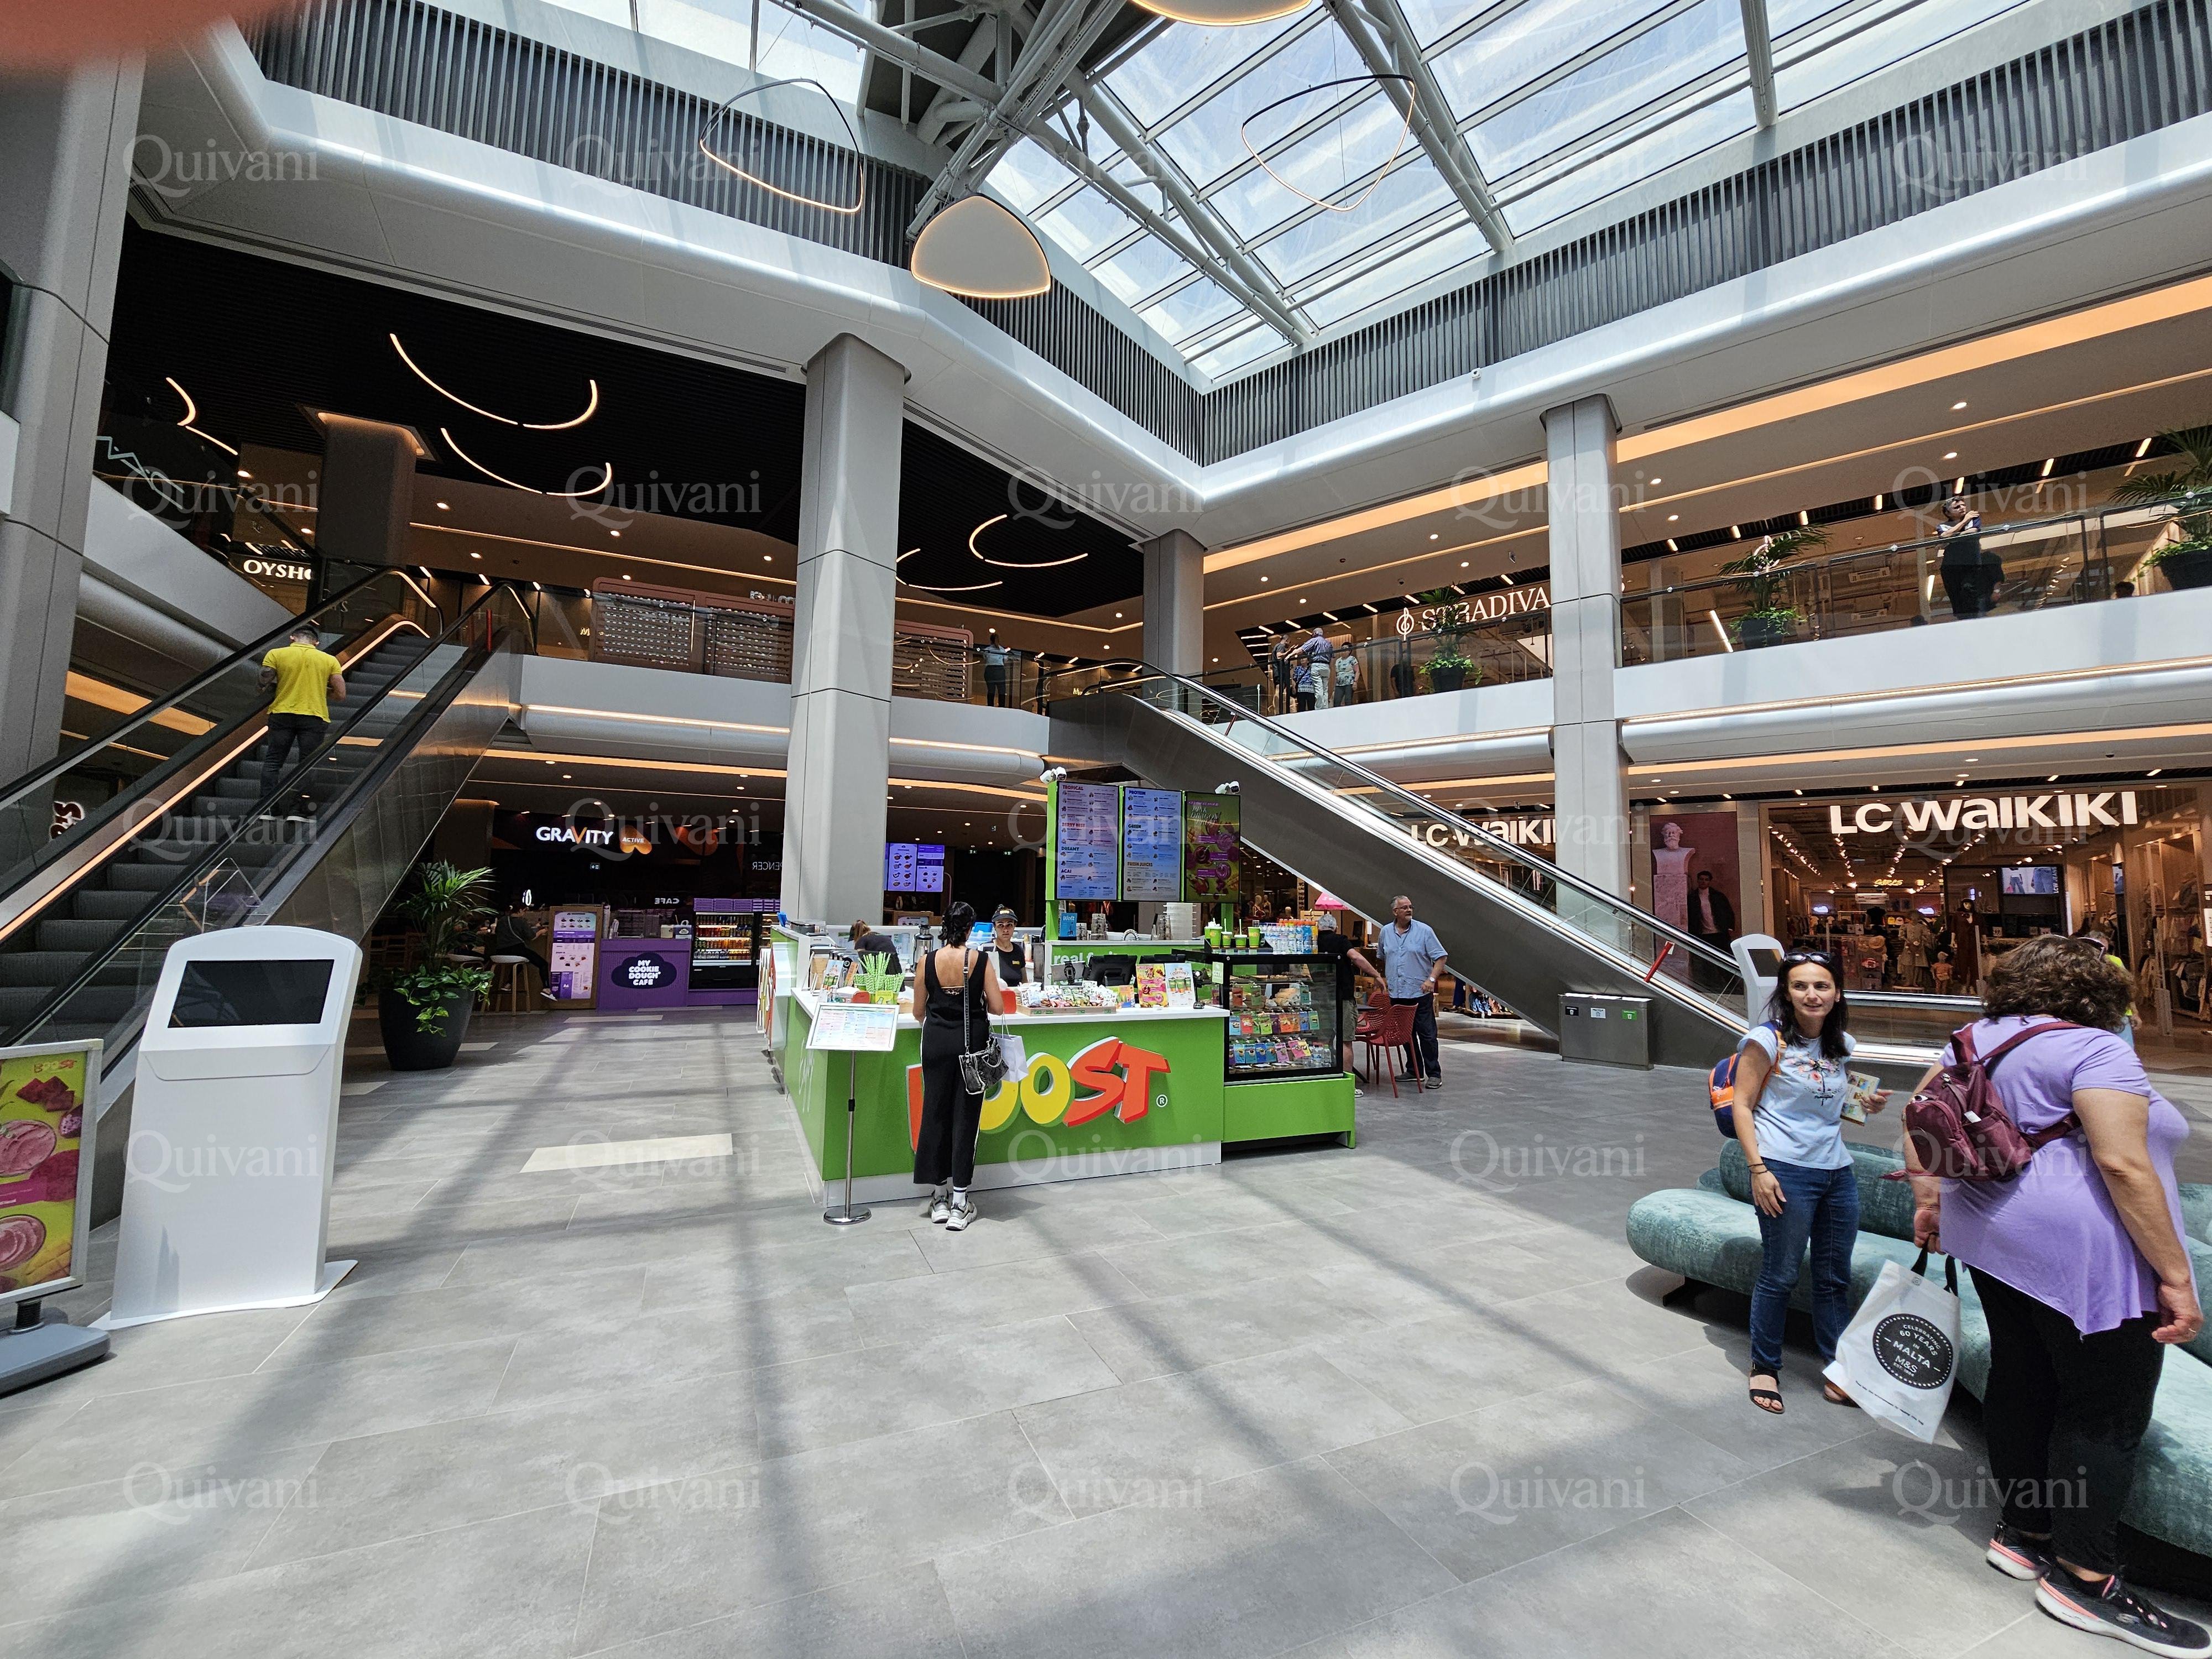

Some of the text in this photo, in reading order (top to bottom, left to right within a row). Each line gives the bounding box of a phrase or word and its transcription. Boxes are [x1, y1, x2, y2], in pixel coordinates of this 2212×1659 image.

[1830, 803, 1893, 834] LC
[536, 826, 614, 845] GRAVITY
[1411, 823, 1449, 847] LC
[1903, 1324, 1941, 1349] CELEBRATING
[1913, 1333, 1938, 1356] YEARS
[1892, 1340, 1931, 1369] MALTA
[1895, 1355, 1918, 1373] M&S
